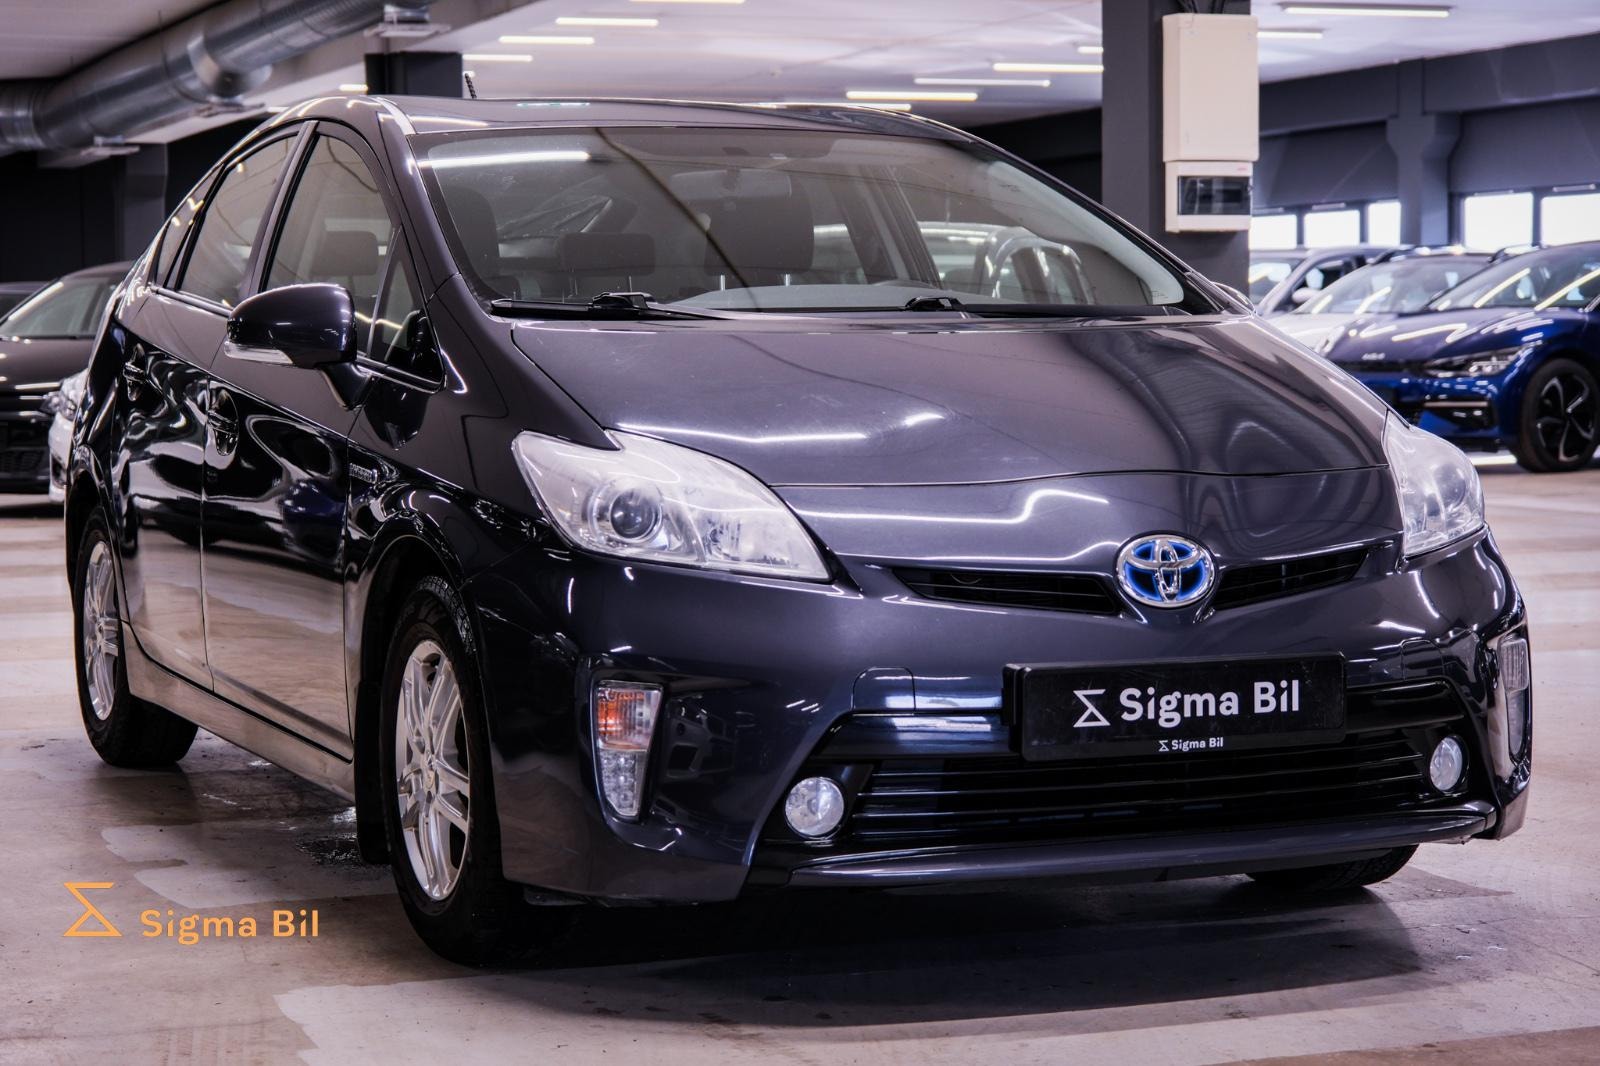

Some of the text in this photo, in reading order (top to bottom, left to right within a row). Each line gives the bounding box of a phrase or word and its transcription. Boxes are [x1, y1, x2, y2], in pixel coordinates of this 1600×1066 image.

[1119, 679, 1299, 728] Sigma Bil
[1171, 736, 1224, 752] Sigma Bil
